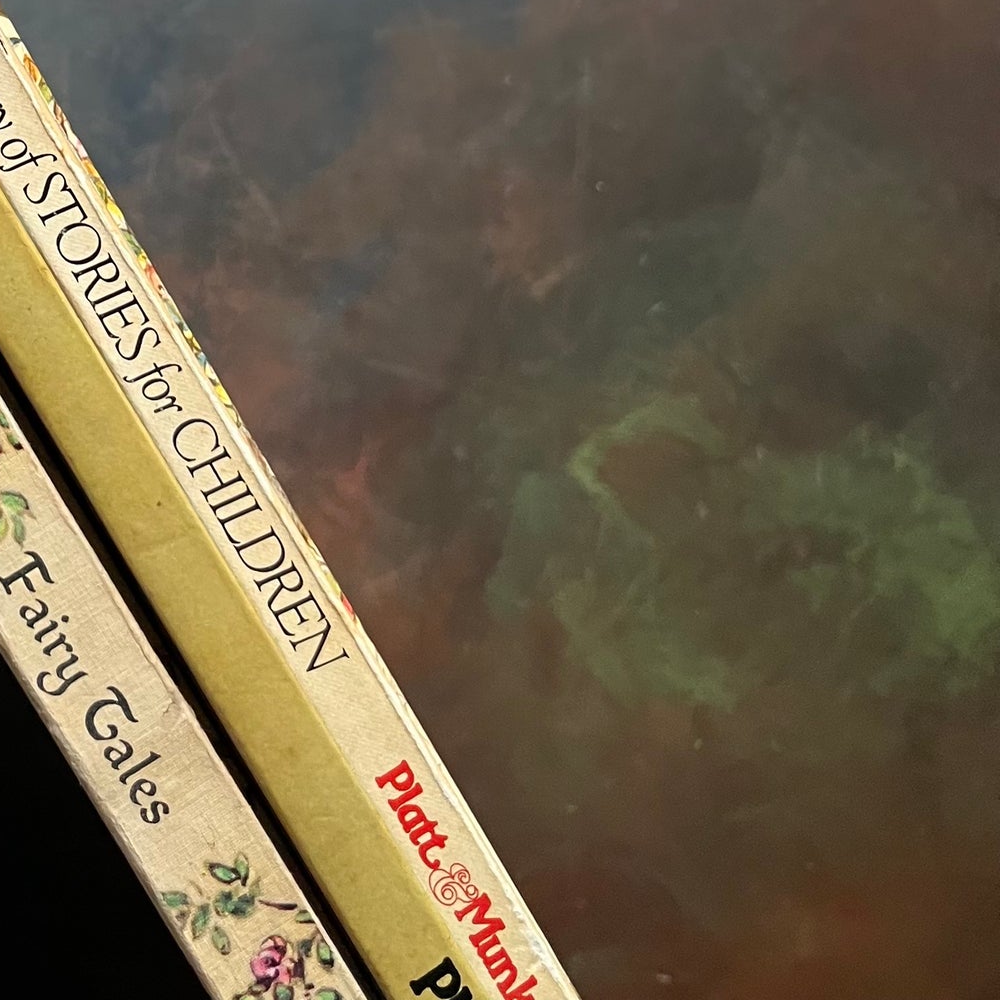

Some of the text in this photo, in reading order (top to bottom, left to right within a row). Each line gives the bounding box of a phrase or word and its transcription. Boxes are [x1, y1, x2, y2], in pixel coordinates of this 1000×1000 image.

[0, 137, 57, 173] of
[23, 171, 162, 362] STORIES
[123, 361, 184, 414] for
[172, 418, 350, 674] CHILDREN
[85, 685, 171, 825] Tales
[375, 759, 449, 869] Platt
